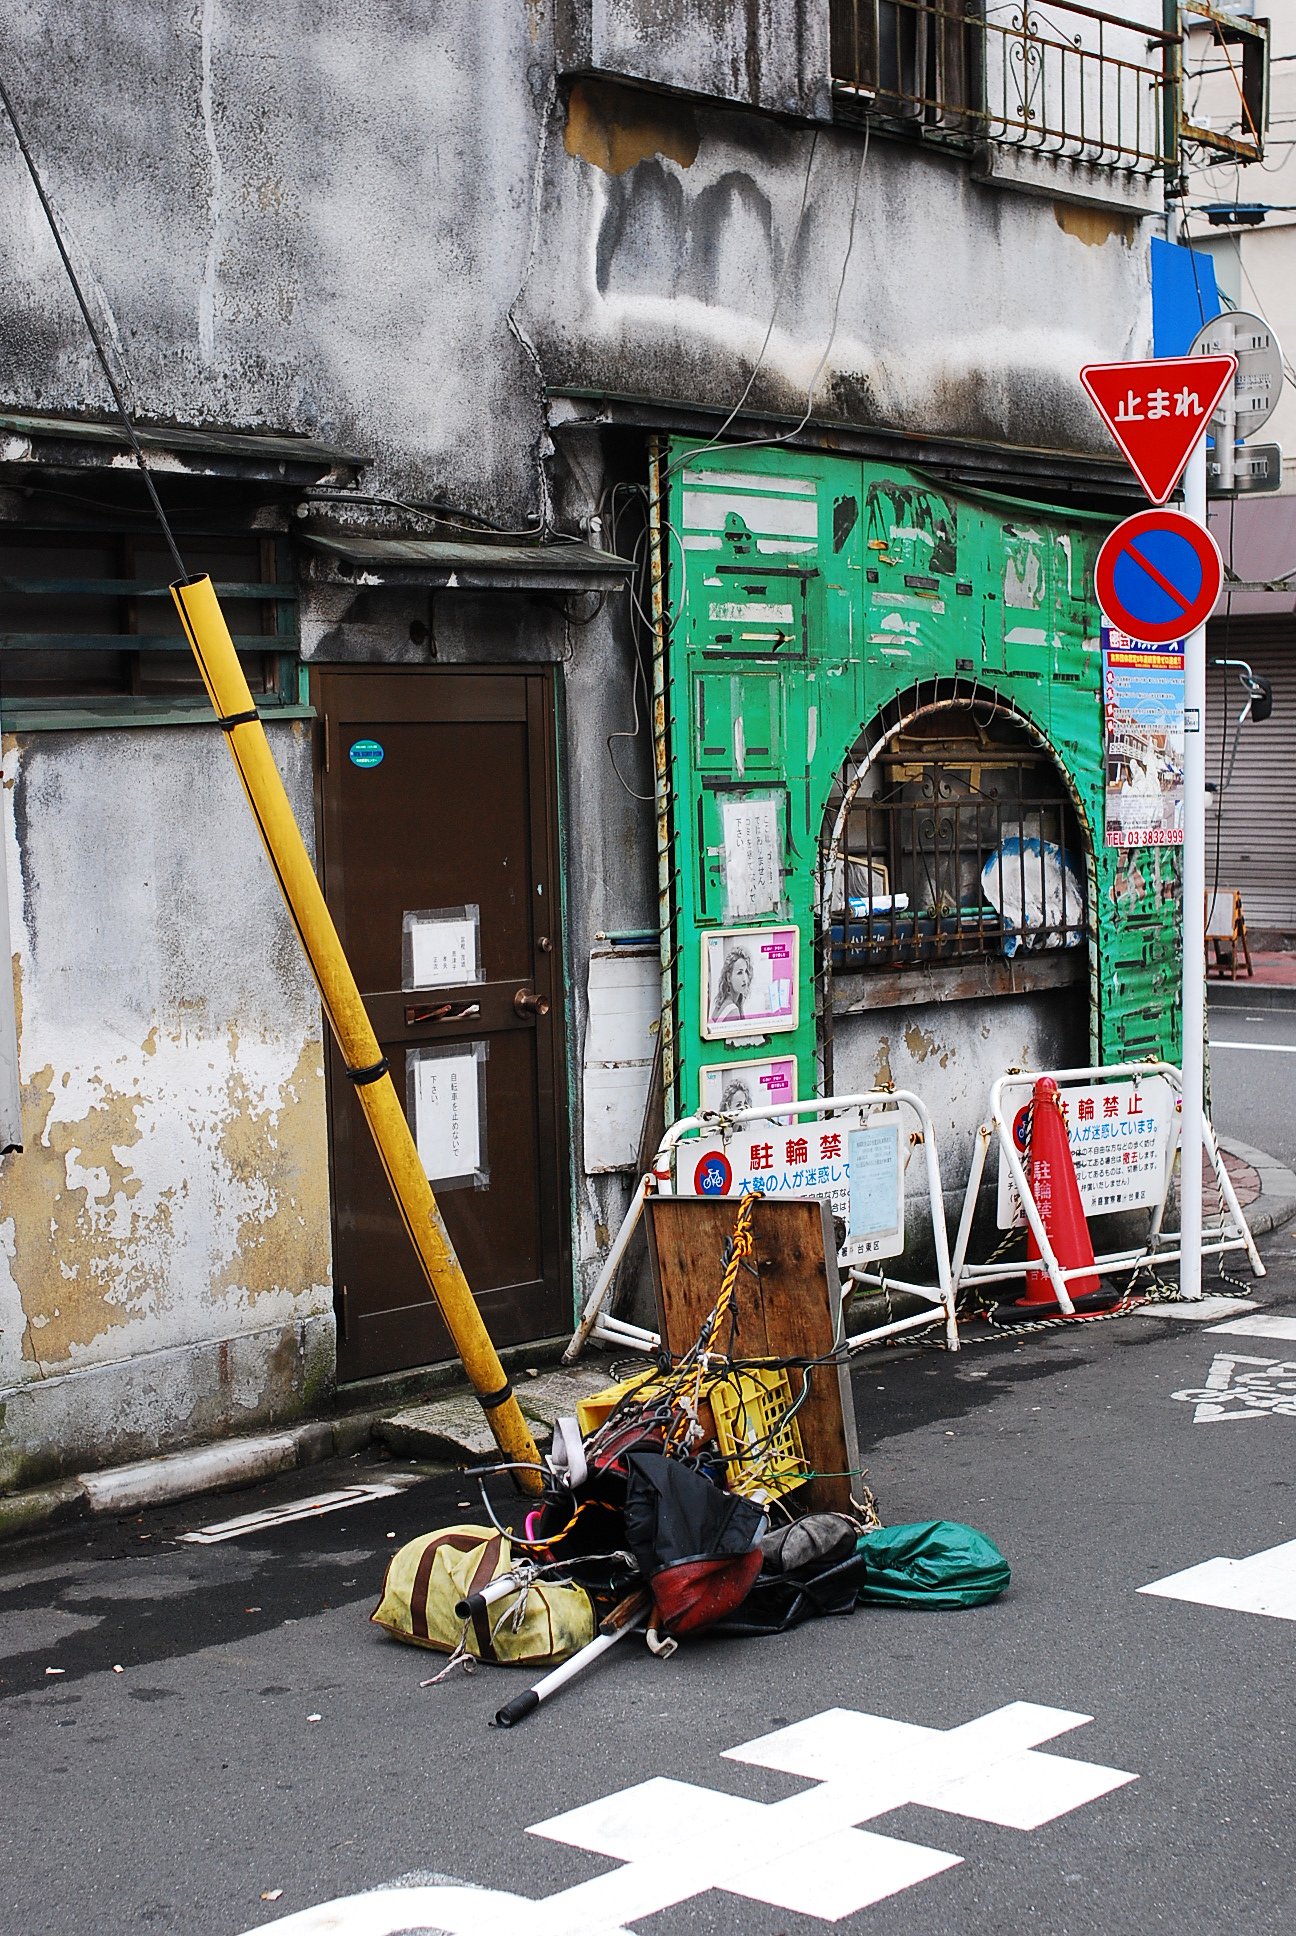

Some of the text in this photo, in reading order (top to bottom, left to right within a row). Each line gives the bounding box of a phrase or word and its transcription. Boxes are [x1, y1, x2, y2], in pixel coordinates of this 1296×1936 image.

[1114, 386, 1204, 422] 止まれ
[1106, 833, 1124, 846] TEL
[749, 1133, 842, 1171] 駐輪禁
